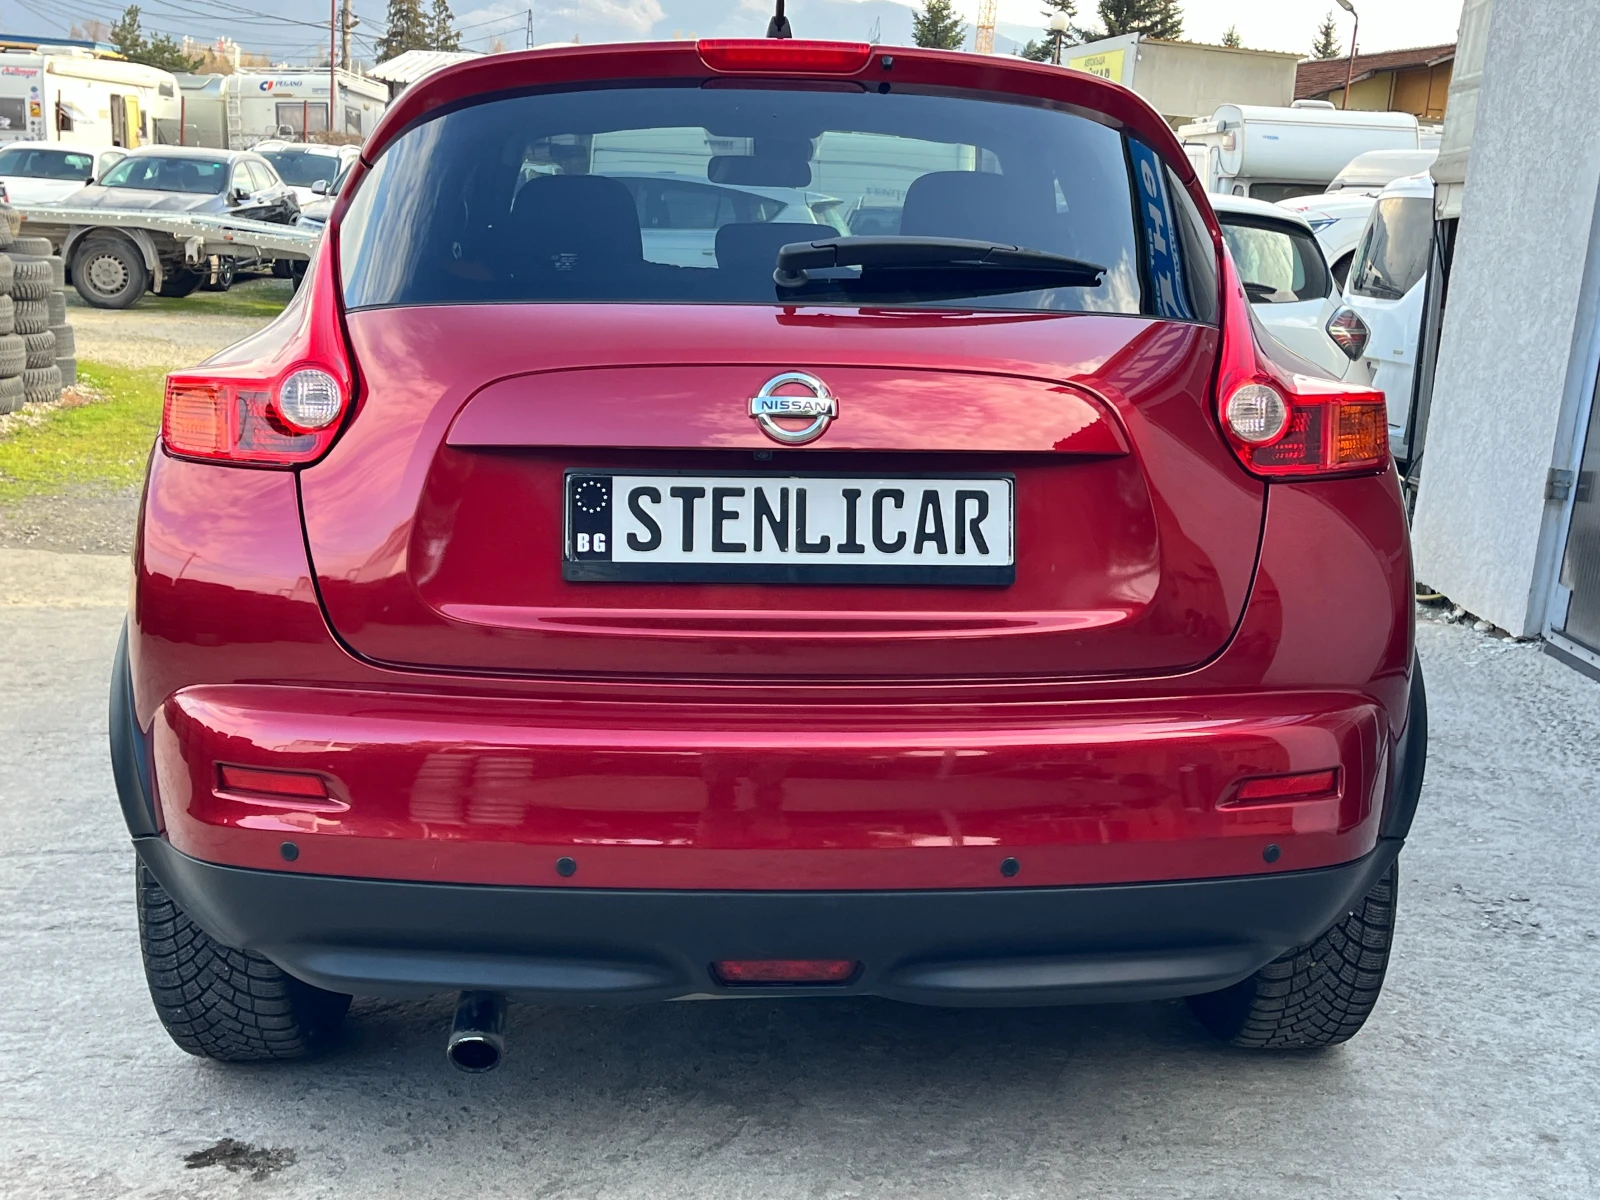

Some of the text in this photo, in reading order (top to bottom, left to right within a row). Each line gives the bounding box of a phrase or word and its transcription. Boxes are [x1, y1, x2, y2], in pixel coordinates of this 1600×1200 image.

[761, 400, 827, 411] NISSAN
[626, 486, 990, 554] STENLICAR
[576, 533, 606, 552] BG
